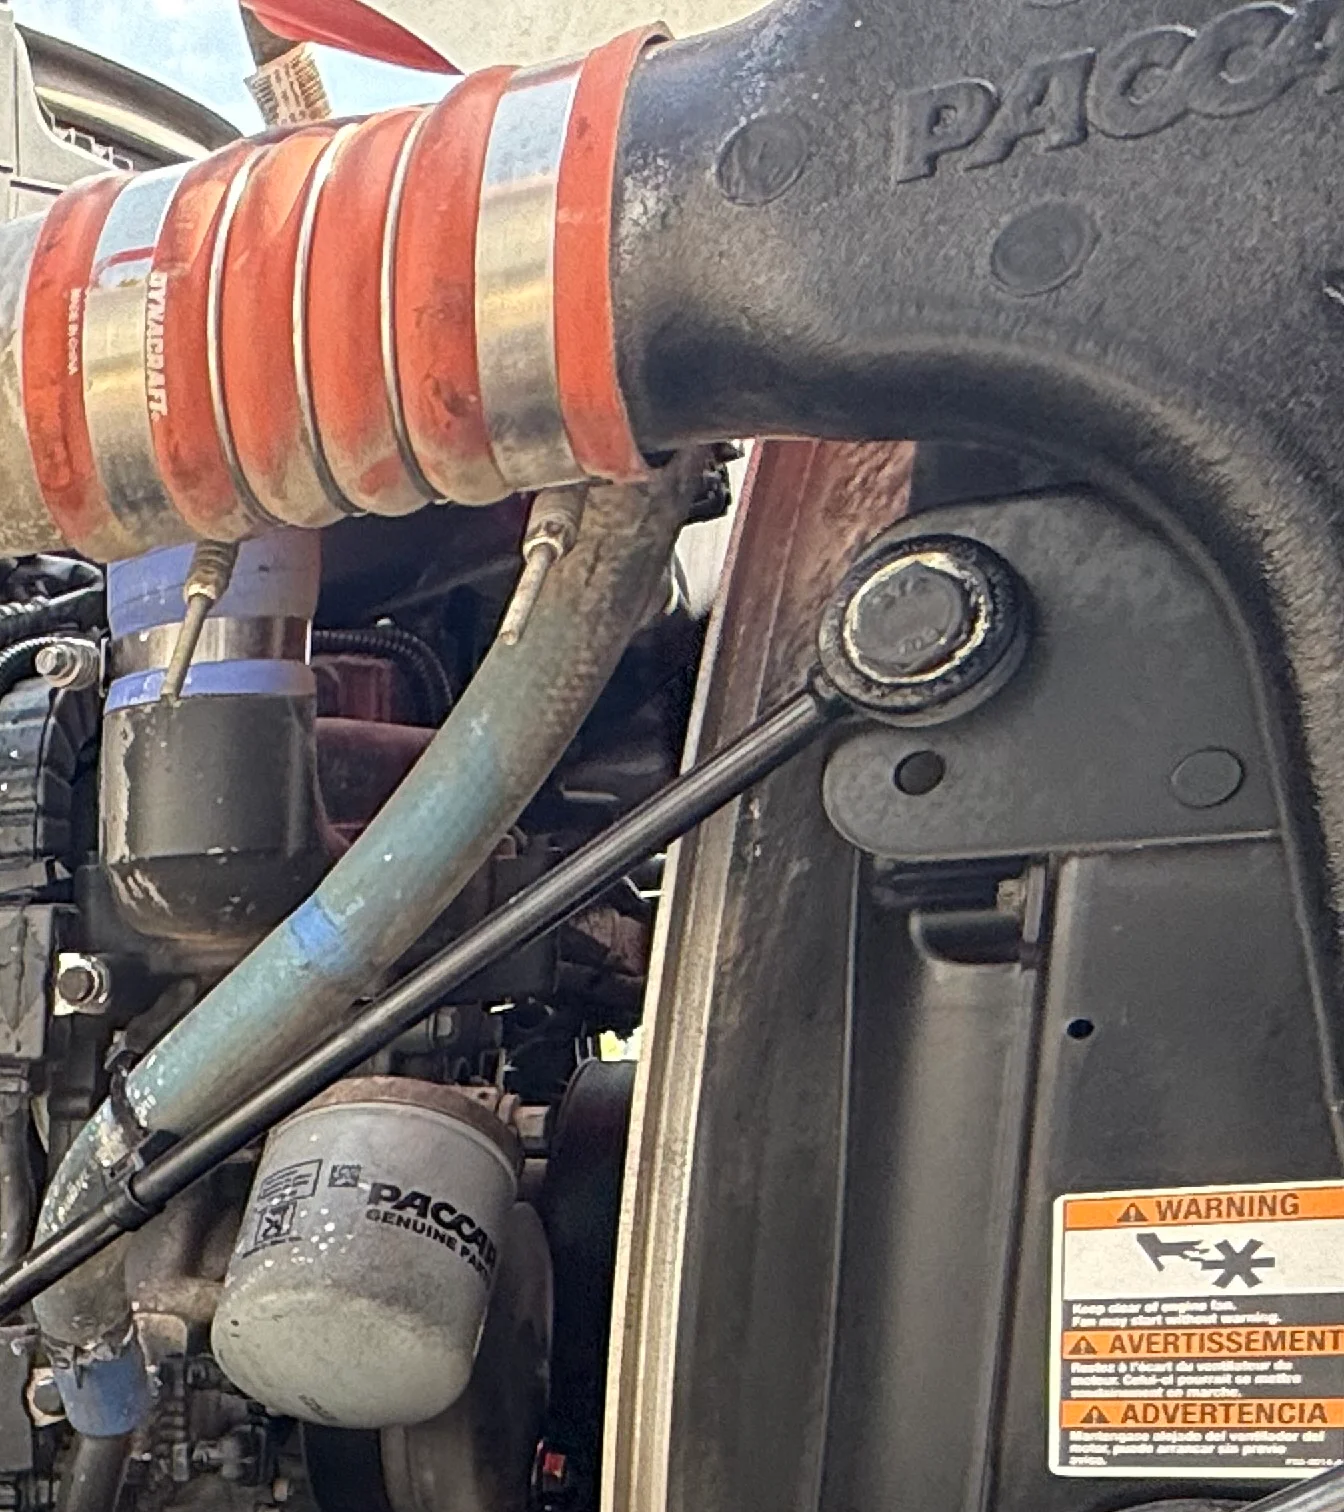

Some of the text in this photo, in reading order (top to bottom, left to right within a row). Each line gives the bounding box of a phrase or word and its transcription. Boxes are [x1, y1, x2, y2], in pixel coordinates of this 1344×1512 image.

[1156, 1194, 1299, 1221] WARNING
[365, 1208, 458, 1252] GENUINE
[1109, 1329, 1344, 1354] AVERTISSEMENT
[1120, 1402, 1329, 1425] ADVERTENCIA
